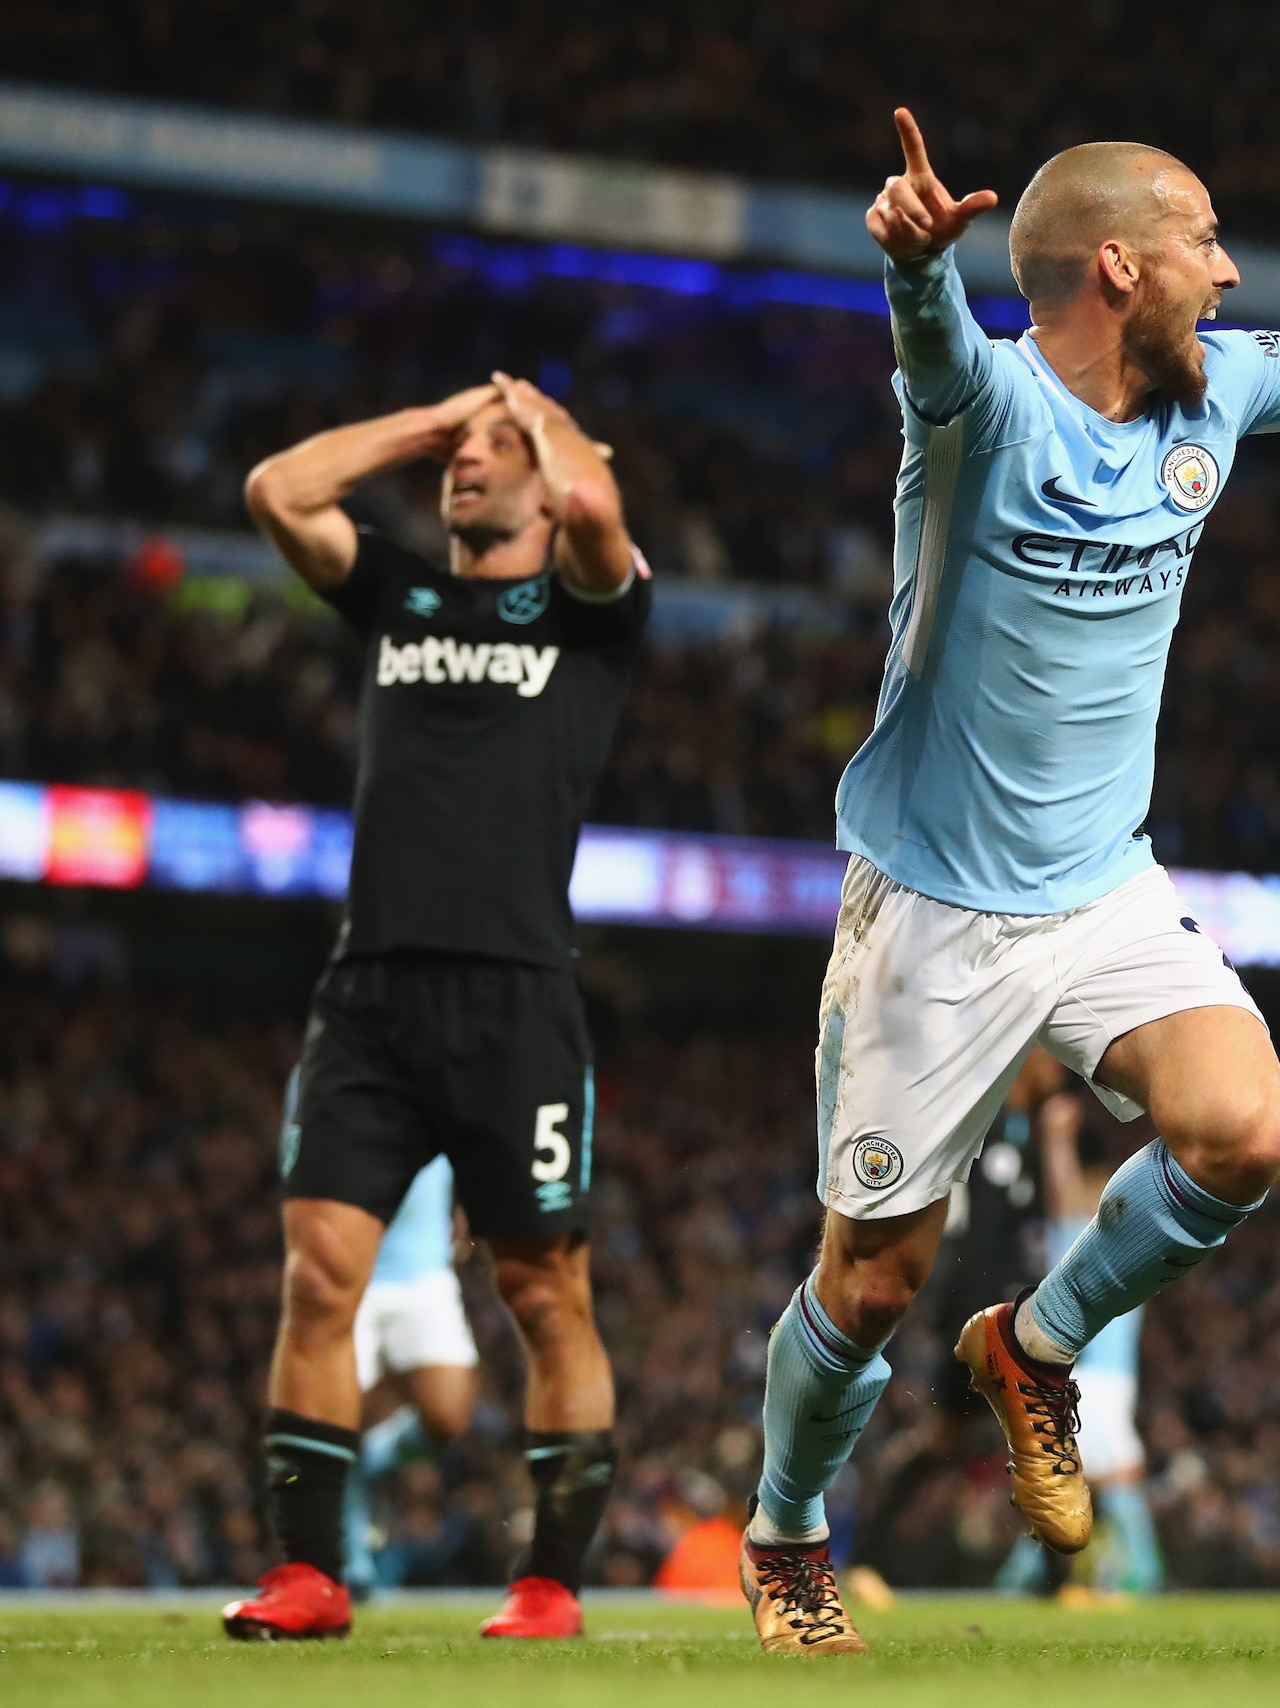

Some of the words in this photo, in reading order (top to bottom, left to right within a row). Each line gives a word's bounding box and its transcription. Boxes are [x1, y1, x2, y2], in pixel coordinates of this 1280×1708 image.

[1167, 448, 1206, 481] MANCHESTER
[1195, 493, 1209, 507] CITY
[1053, 566, 1183, 597] AIRWAYS
[377, 634, 560, 698] betway
[531, 1102, 571, 1183] 5
[858, 1140, 898, 1161] MANCHESTER
[866, 1178, 882, 1186] CITY
